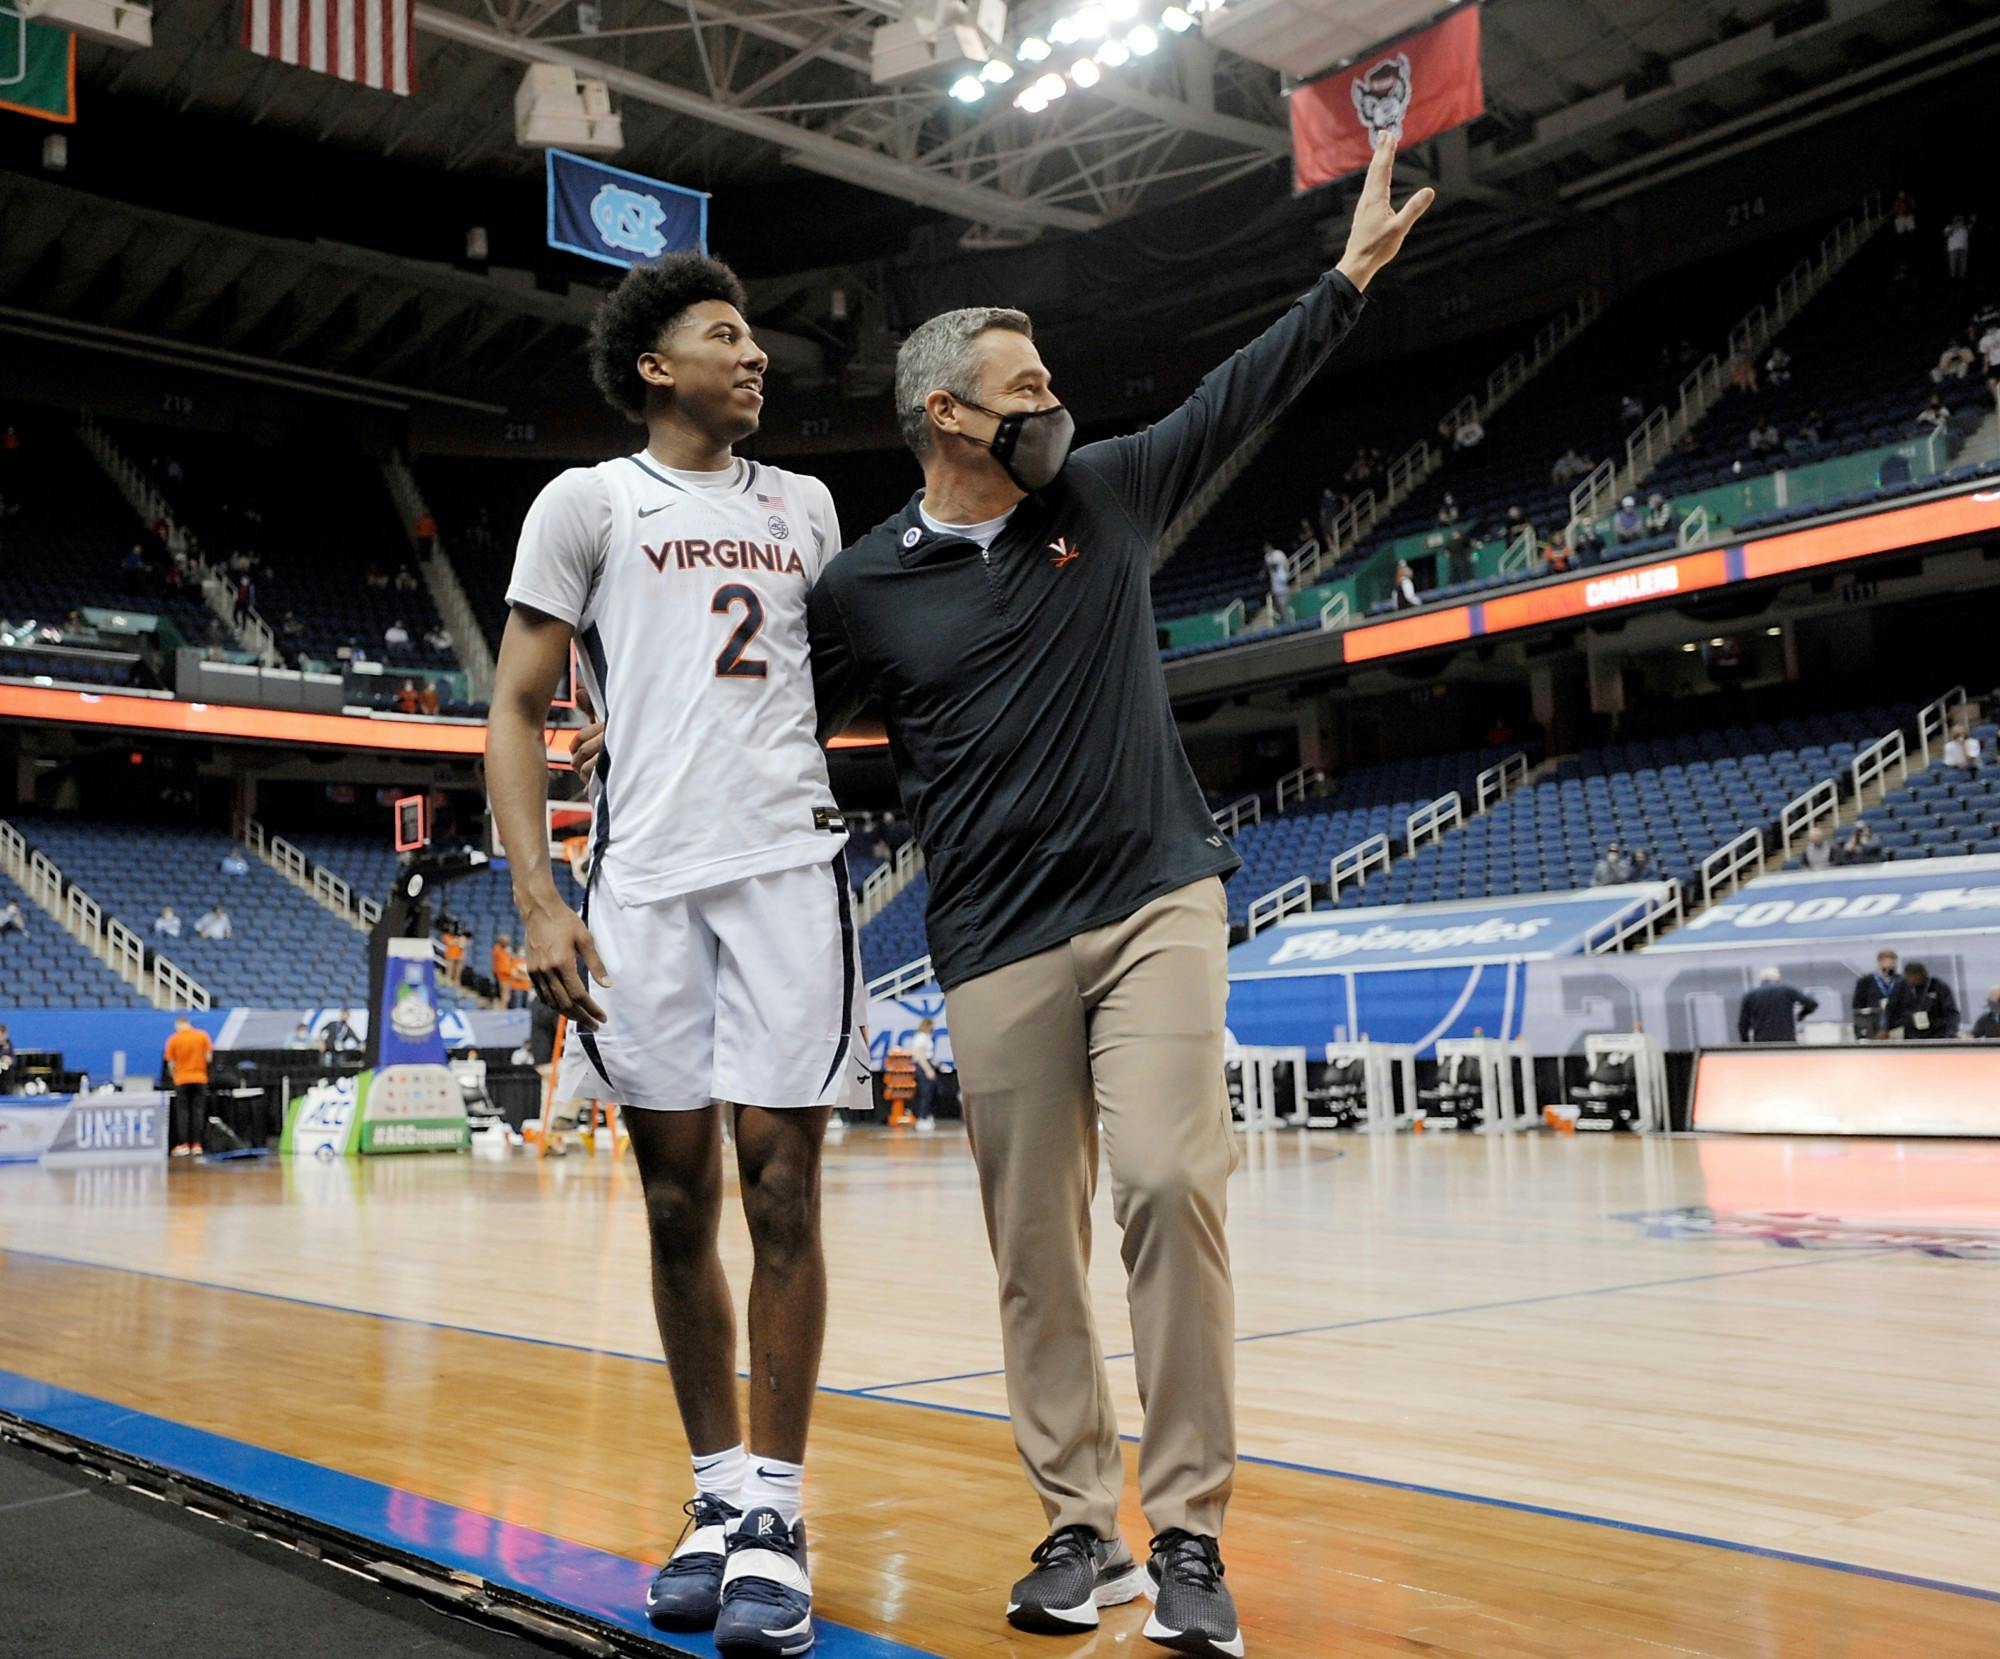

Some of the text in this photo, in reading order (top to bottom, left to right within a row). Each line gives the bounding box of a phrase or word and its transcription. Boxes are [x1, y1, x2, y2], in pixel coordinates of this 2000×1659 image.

[640, 539, 806, 579] VIRGINIA
[711, 583, 768, 679] 2
[1685, 893, 1903, 930] FOOD
[75, 1108, 156, 1149] UNITE
